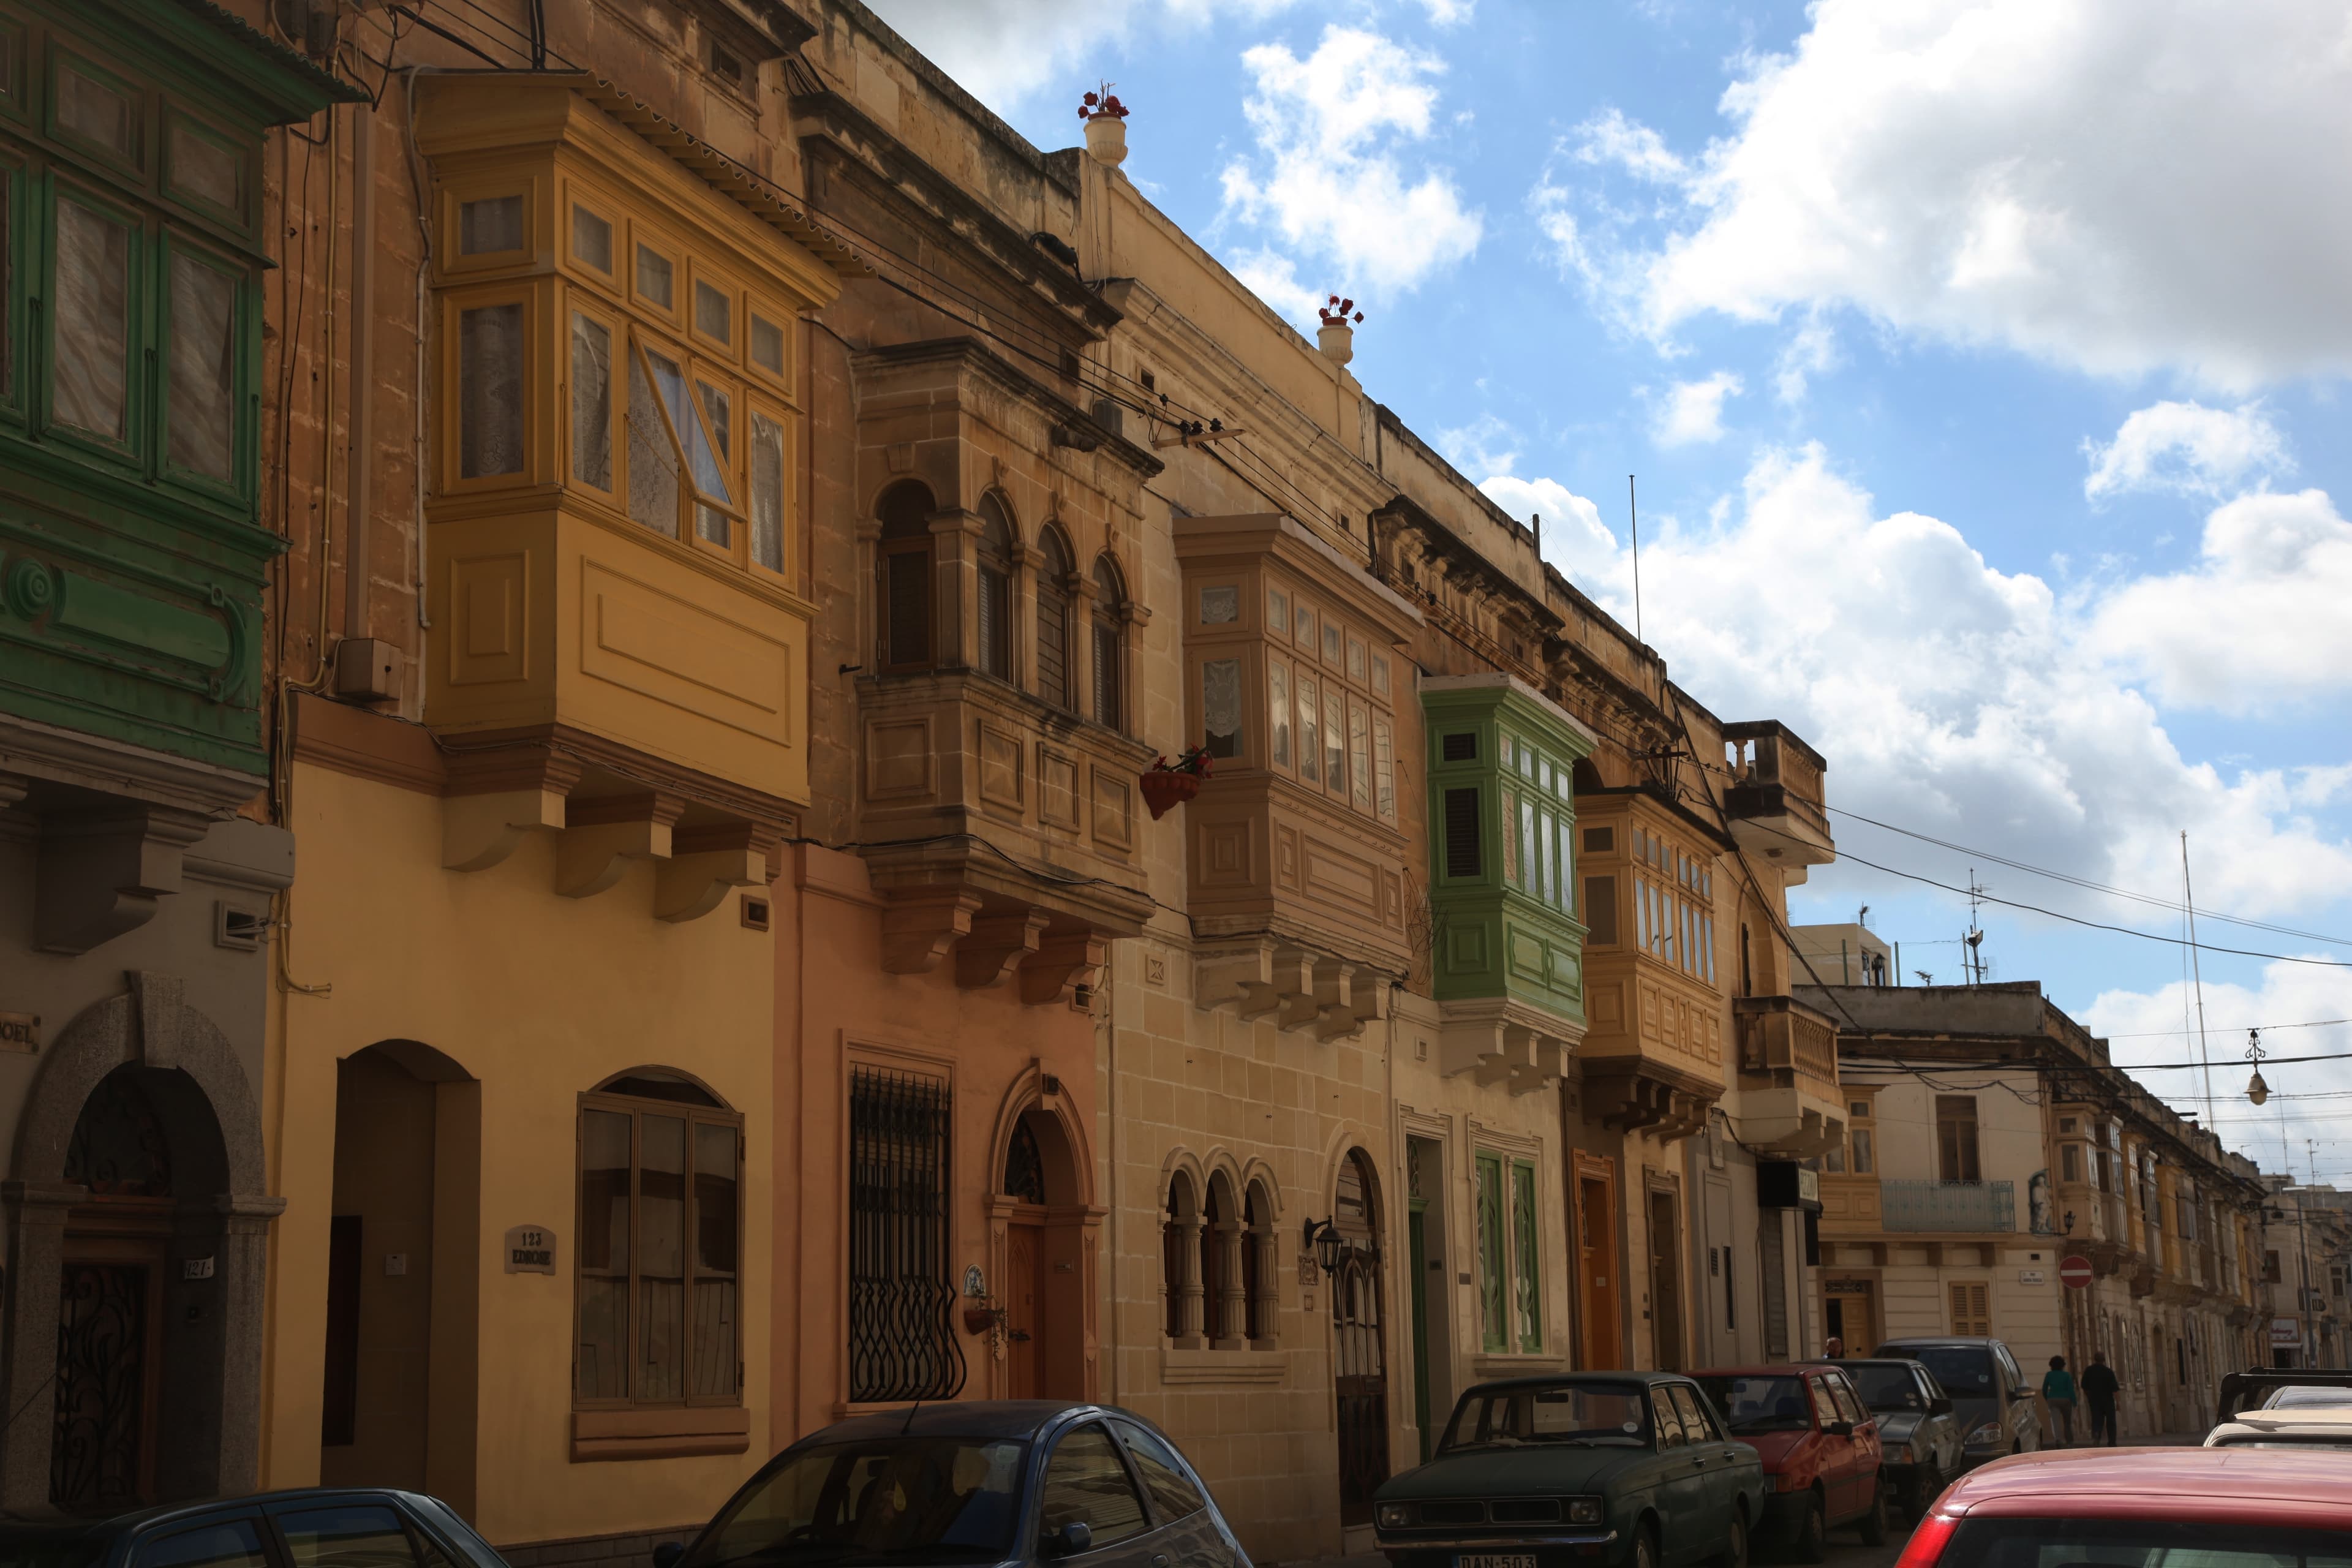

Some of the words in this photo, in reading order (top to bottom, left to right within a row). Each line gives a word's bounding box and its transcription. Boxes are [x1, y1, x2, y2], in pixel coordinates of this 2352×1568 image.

[0, 1022, 34, 1044] OEL
[522, 1232, 541, 1246] 123
[512, 1250, 551, 1265] EDROSE
